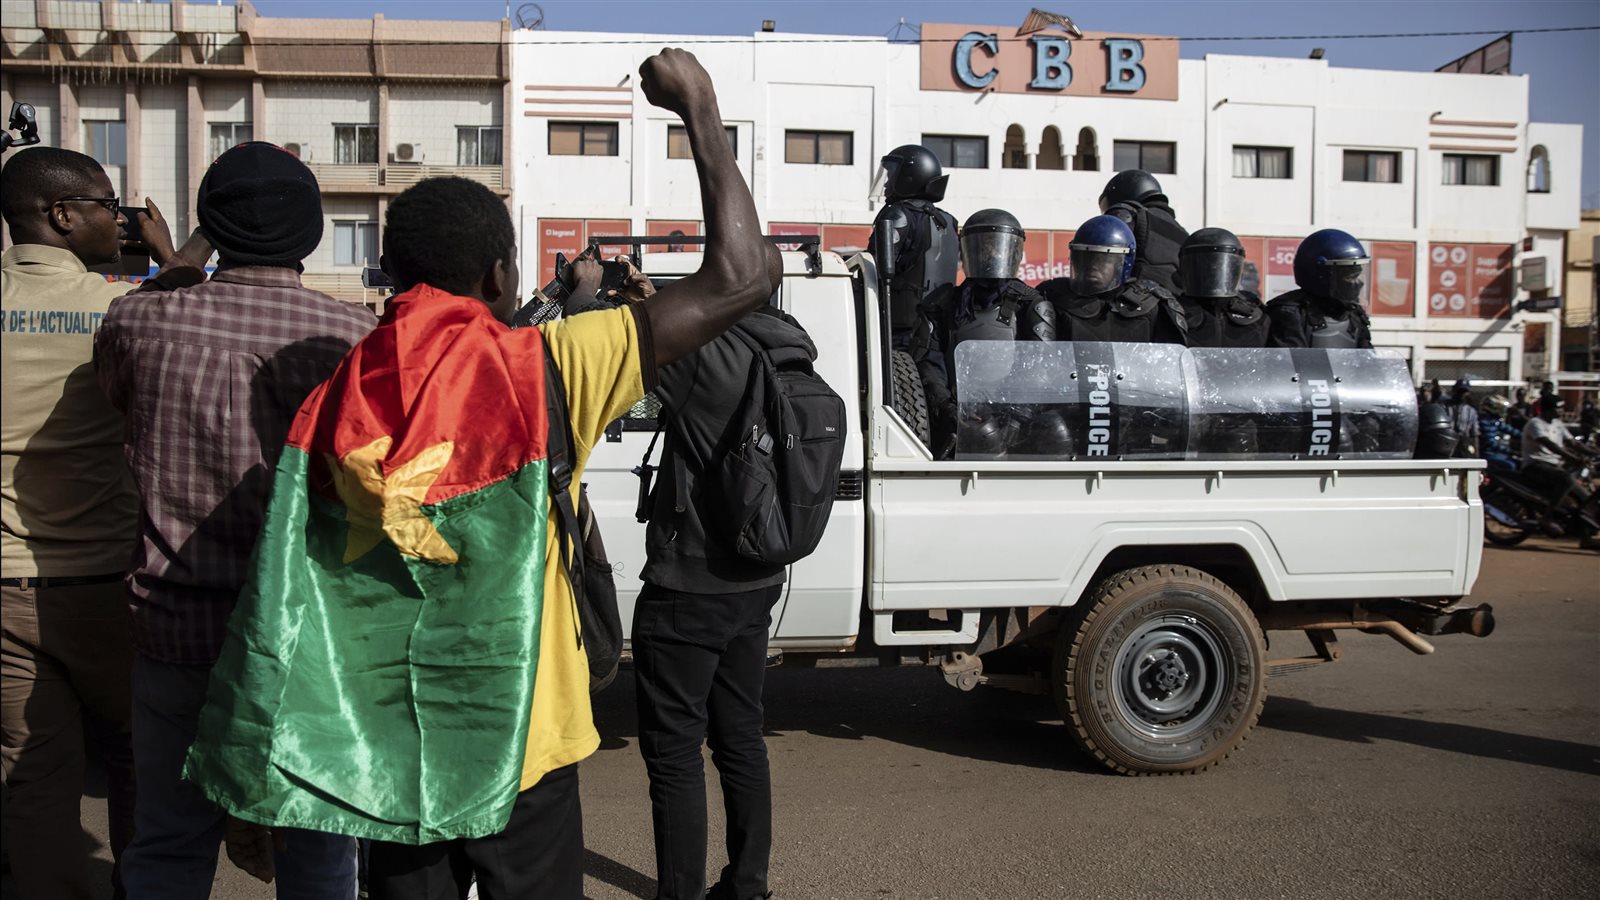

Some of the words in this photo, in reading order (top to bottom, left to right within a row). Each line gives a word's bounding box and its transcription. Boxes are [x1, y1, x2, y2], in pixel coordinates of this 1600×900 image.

[954, 31, 1146, 91] CBB
[9, 310, 26, 333] DE
[29, 310, 107, 334] L'ACTUALIT
[1087, 376, 1111, 457] POLICE
[1307, 379, 1333, 457] POLICE
[1200, 662, 1250, 751] DUNLOP
